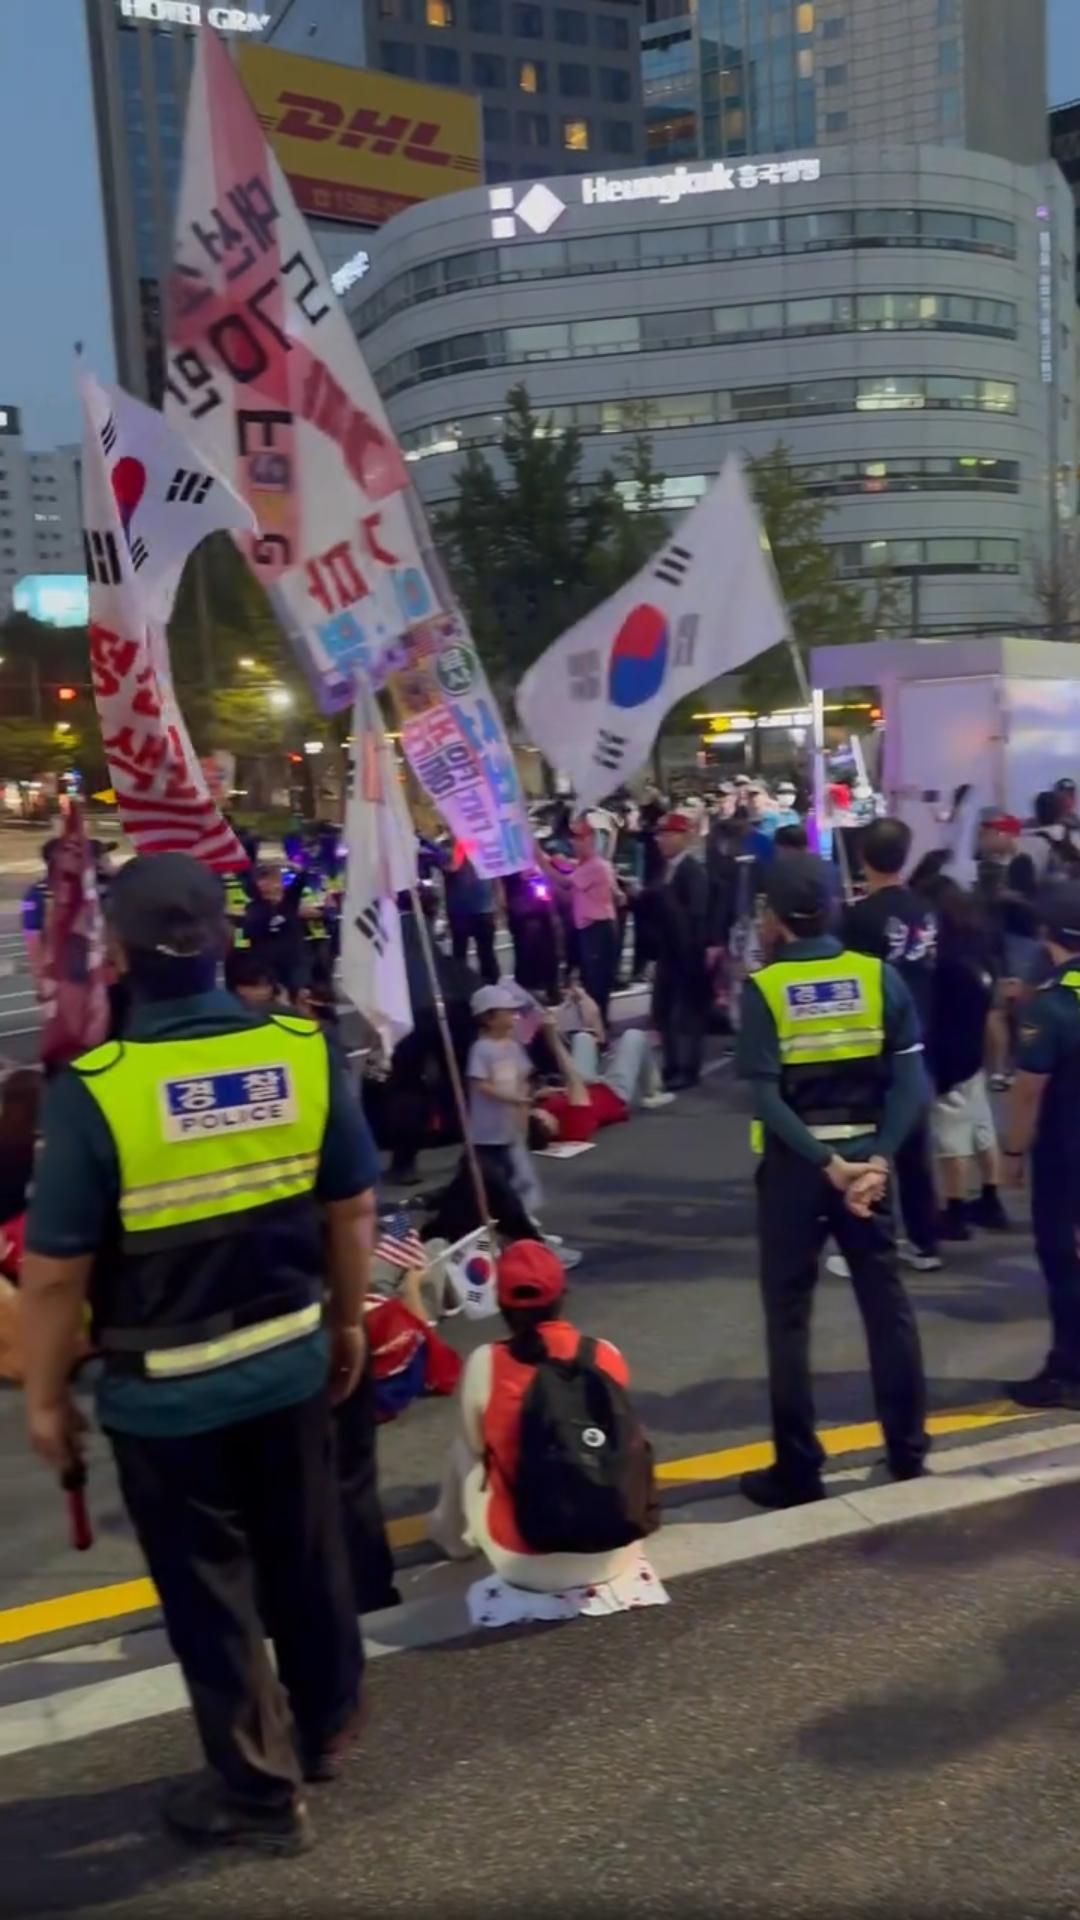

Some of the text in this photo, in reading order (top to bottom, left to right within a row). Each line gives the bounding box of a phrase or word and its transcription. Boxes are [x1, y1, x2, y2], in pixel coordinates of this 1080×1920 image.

[120, 0, 202, 26] HOTEL
[275, 91, 452, 166] DHL
[582, 162, 735, 204] Heungkuk
[174, 1070, 281, 1110] 경찰
[181, 1105, 282, 1132] POLICE
